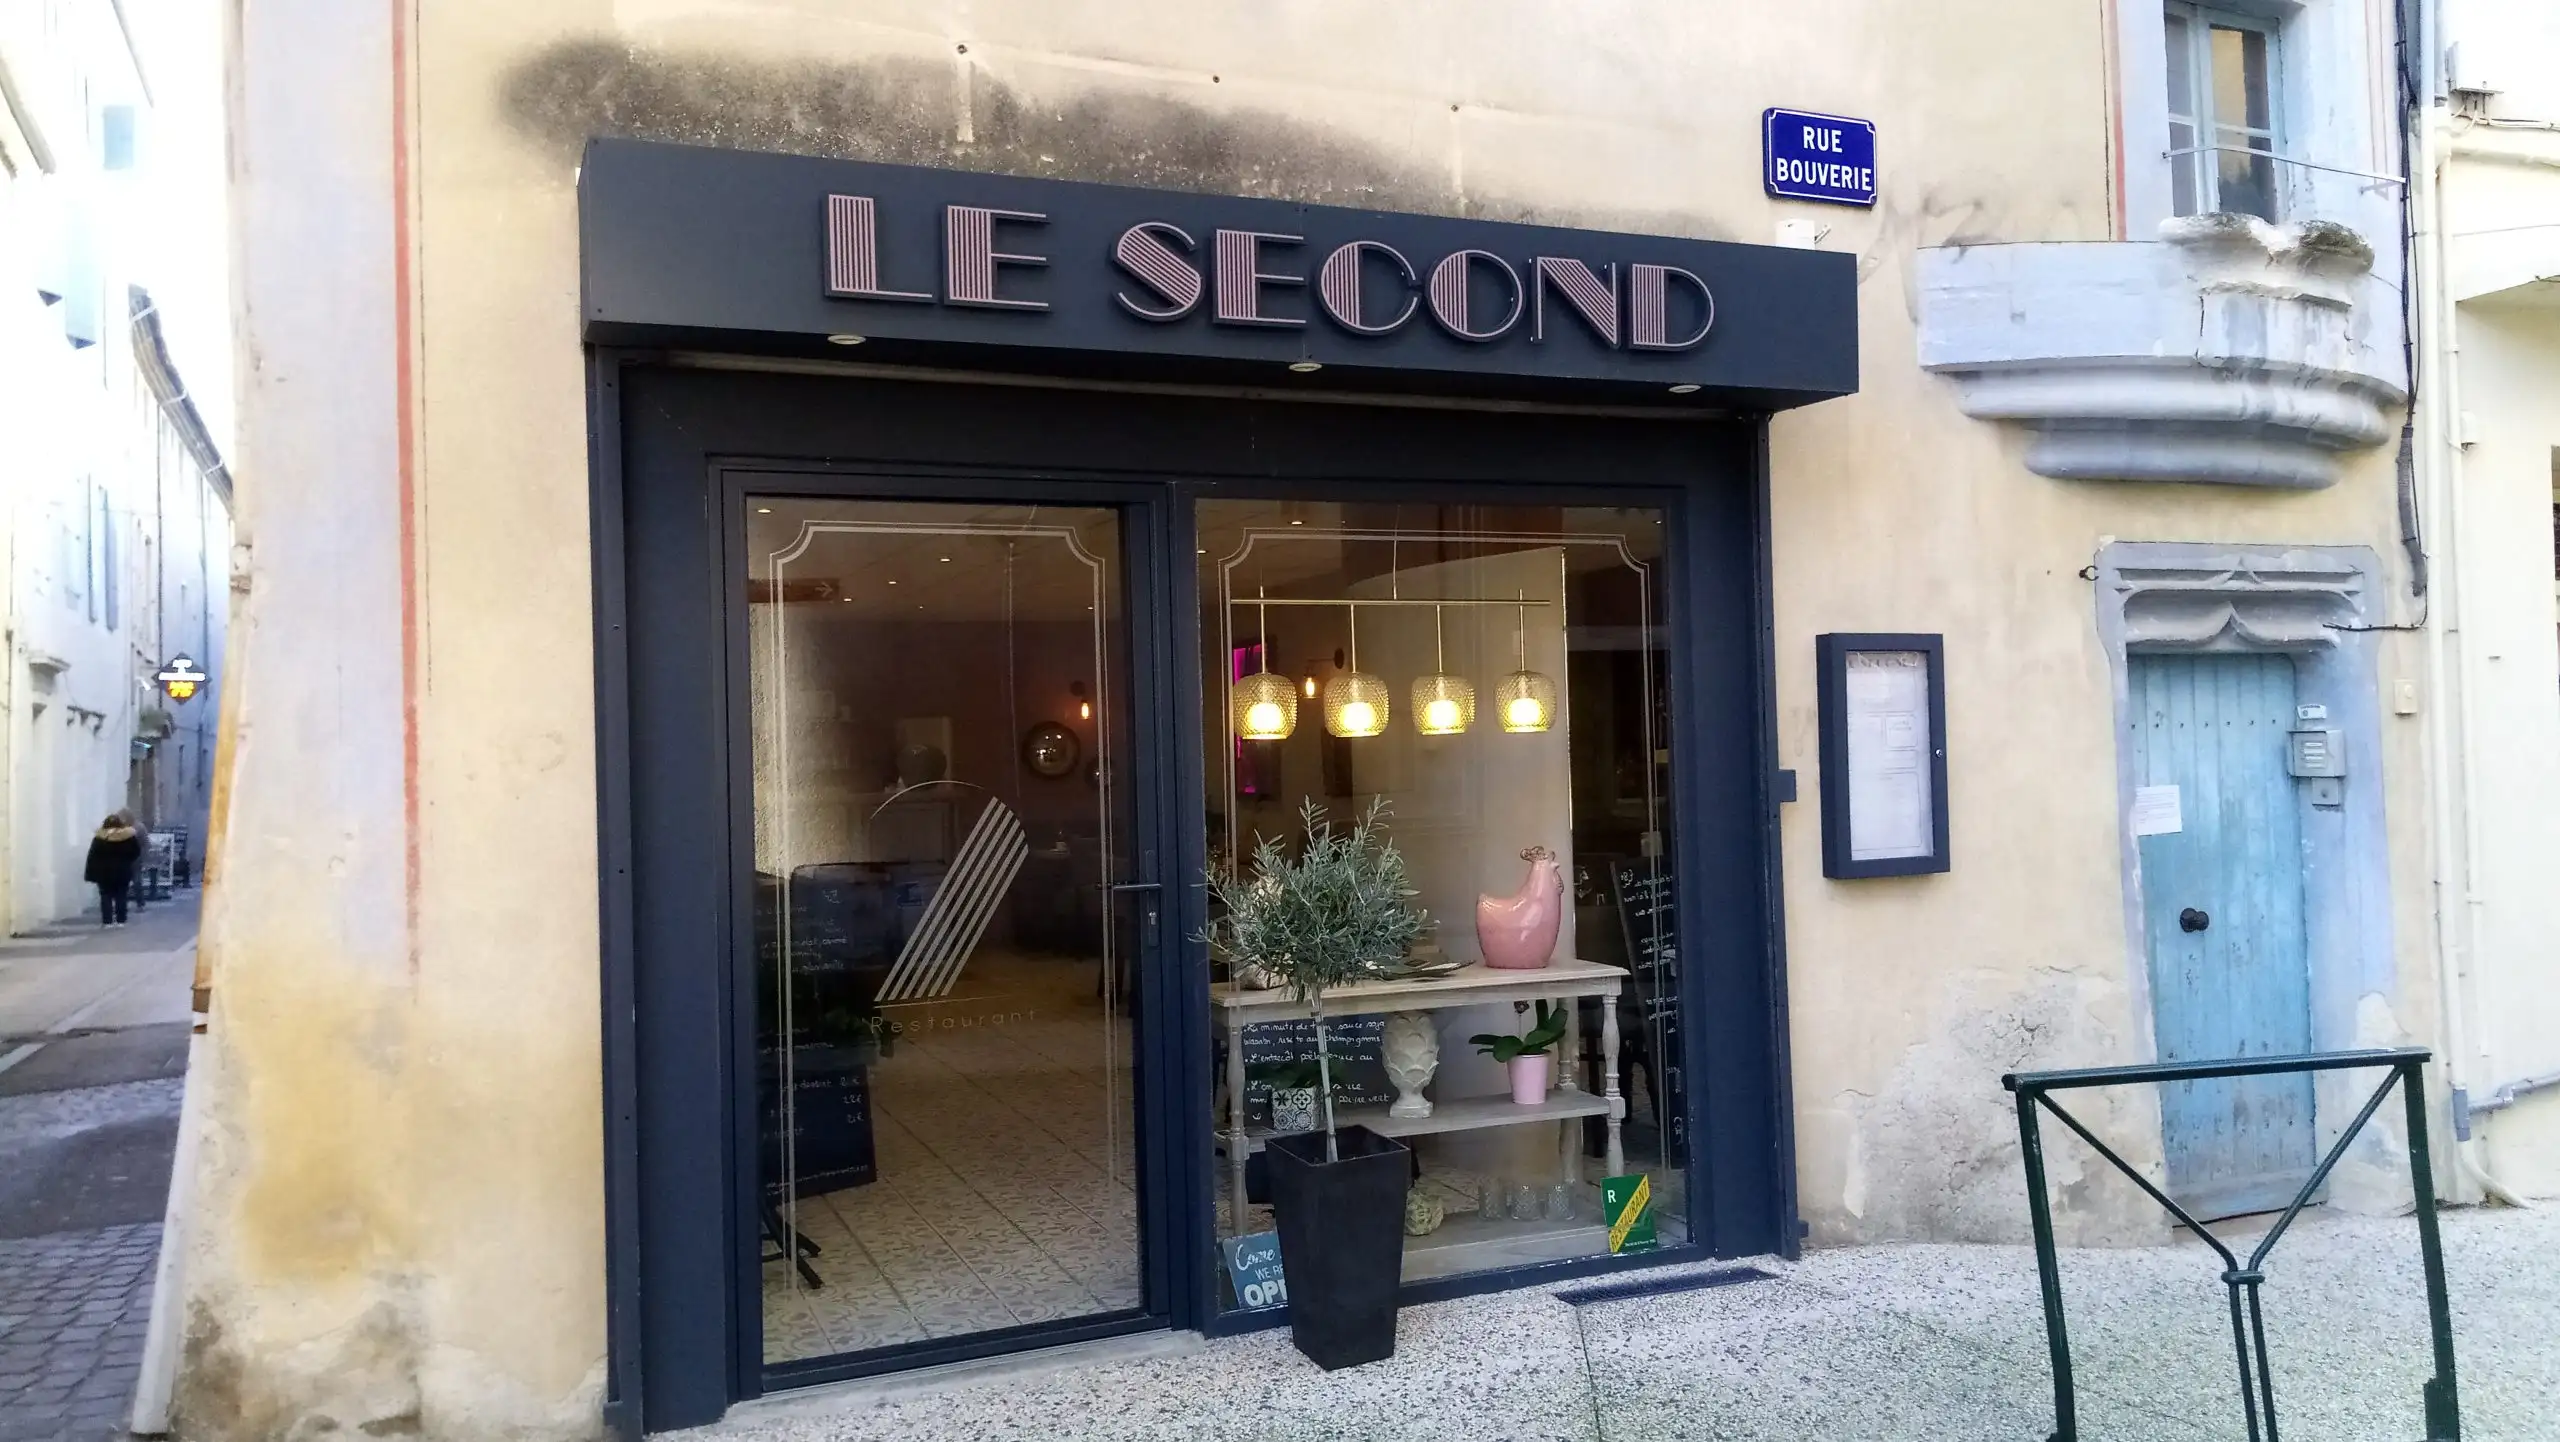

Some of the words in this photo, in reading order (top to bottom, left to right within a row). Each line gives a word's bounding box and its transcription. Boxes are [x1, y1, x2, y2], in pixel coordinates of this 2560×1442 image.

[1803, 125, 1843, 153] RUE
[1776, 157, 1872, 191] BOUVERIE
[827, 193, 1050, 308] LE
[1115, 221, 1716, 348] SECOND
[870, 1009, 1037, 1034] Restaurant
[1337, 1022, 1363, 1032] sauce
[1366, 1021, 1386, 1032] soja
[1359, 1054, 1374, 1062] au
[1368, 1093, 1390, 1103] vert
[1606, 1189, 1617, 1204] R
[1609, 1180, 1649, 1254] RESTAURANT
[1234, 1243, 1276, 1271] Come
